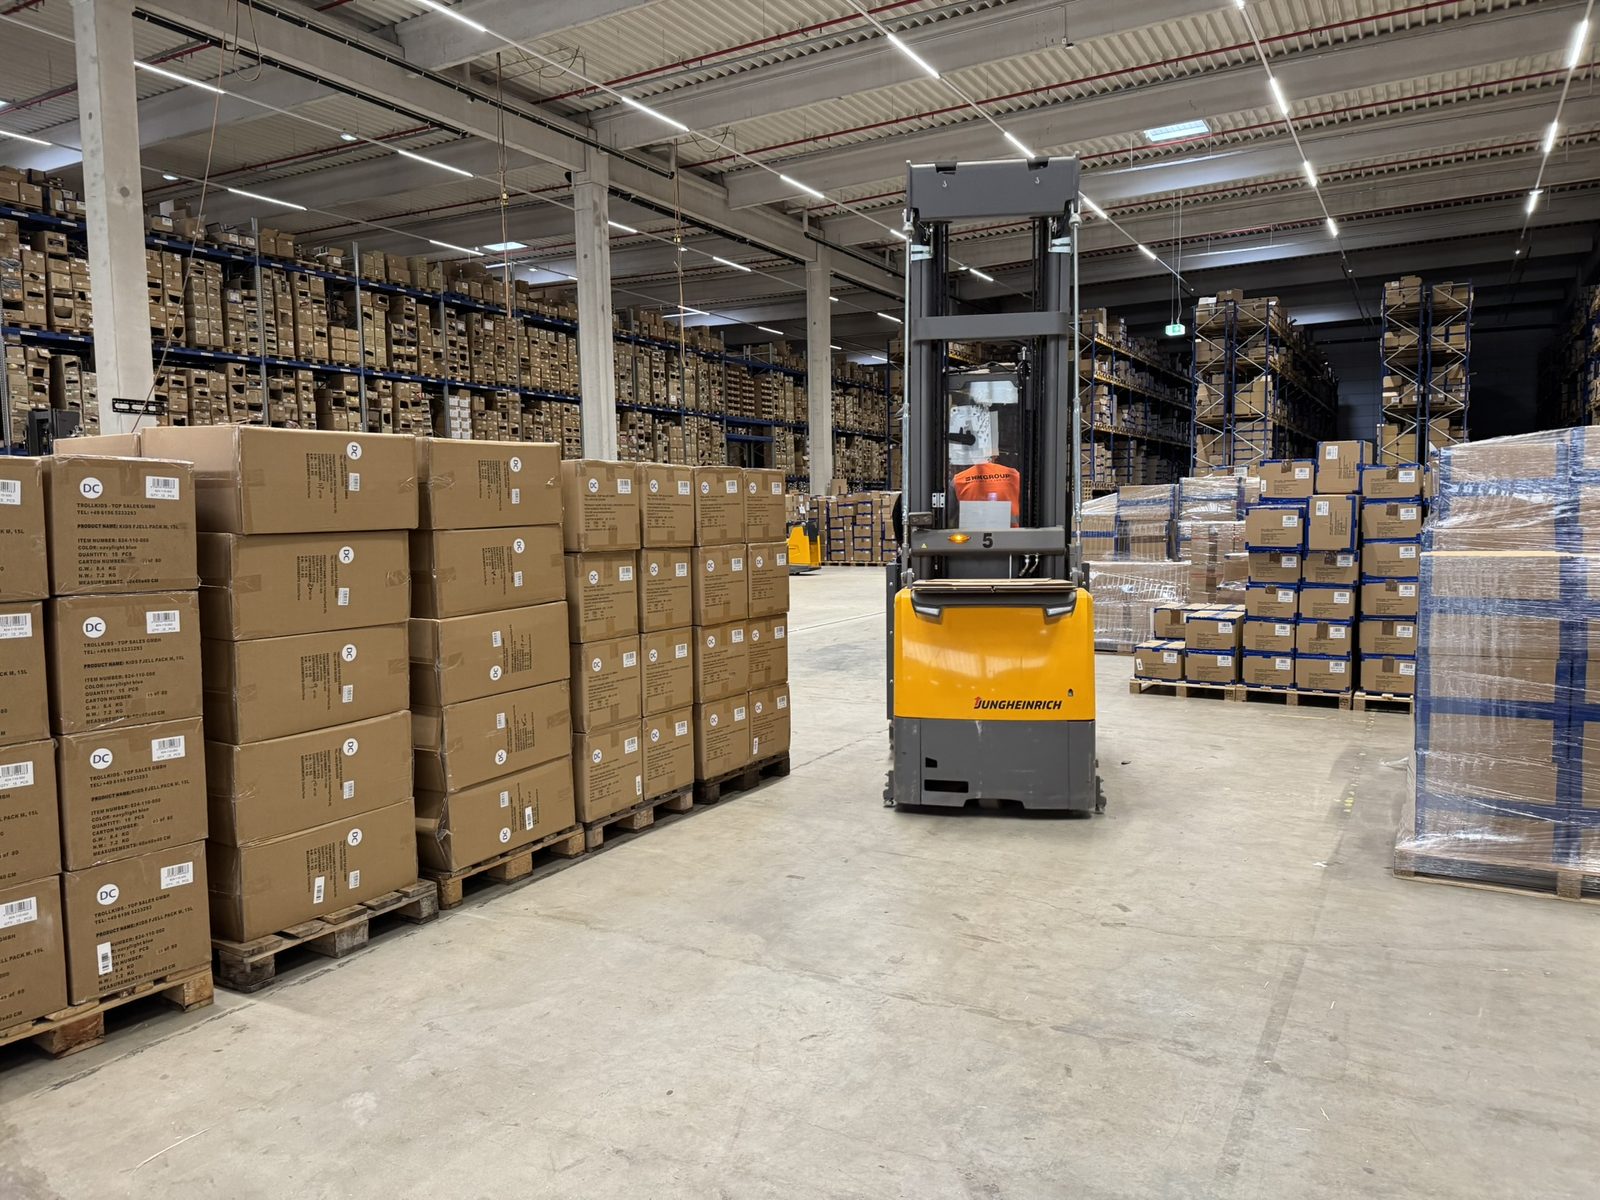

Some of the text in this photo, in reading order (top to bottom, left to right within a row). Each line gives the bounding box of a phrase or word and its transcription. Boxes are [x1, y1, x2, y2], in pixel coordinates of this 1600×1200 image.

[83, 484, 99, 494] DC
[982, 533, 993, 548] 5
[86, 623, 102, 632] DC
[974, 698, 1062, 709] JUNGHEINRICH
[93, 754, 109, 763] DC
[100, 889, 116, 900] DC
